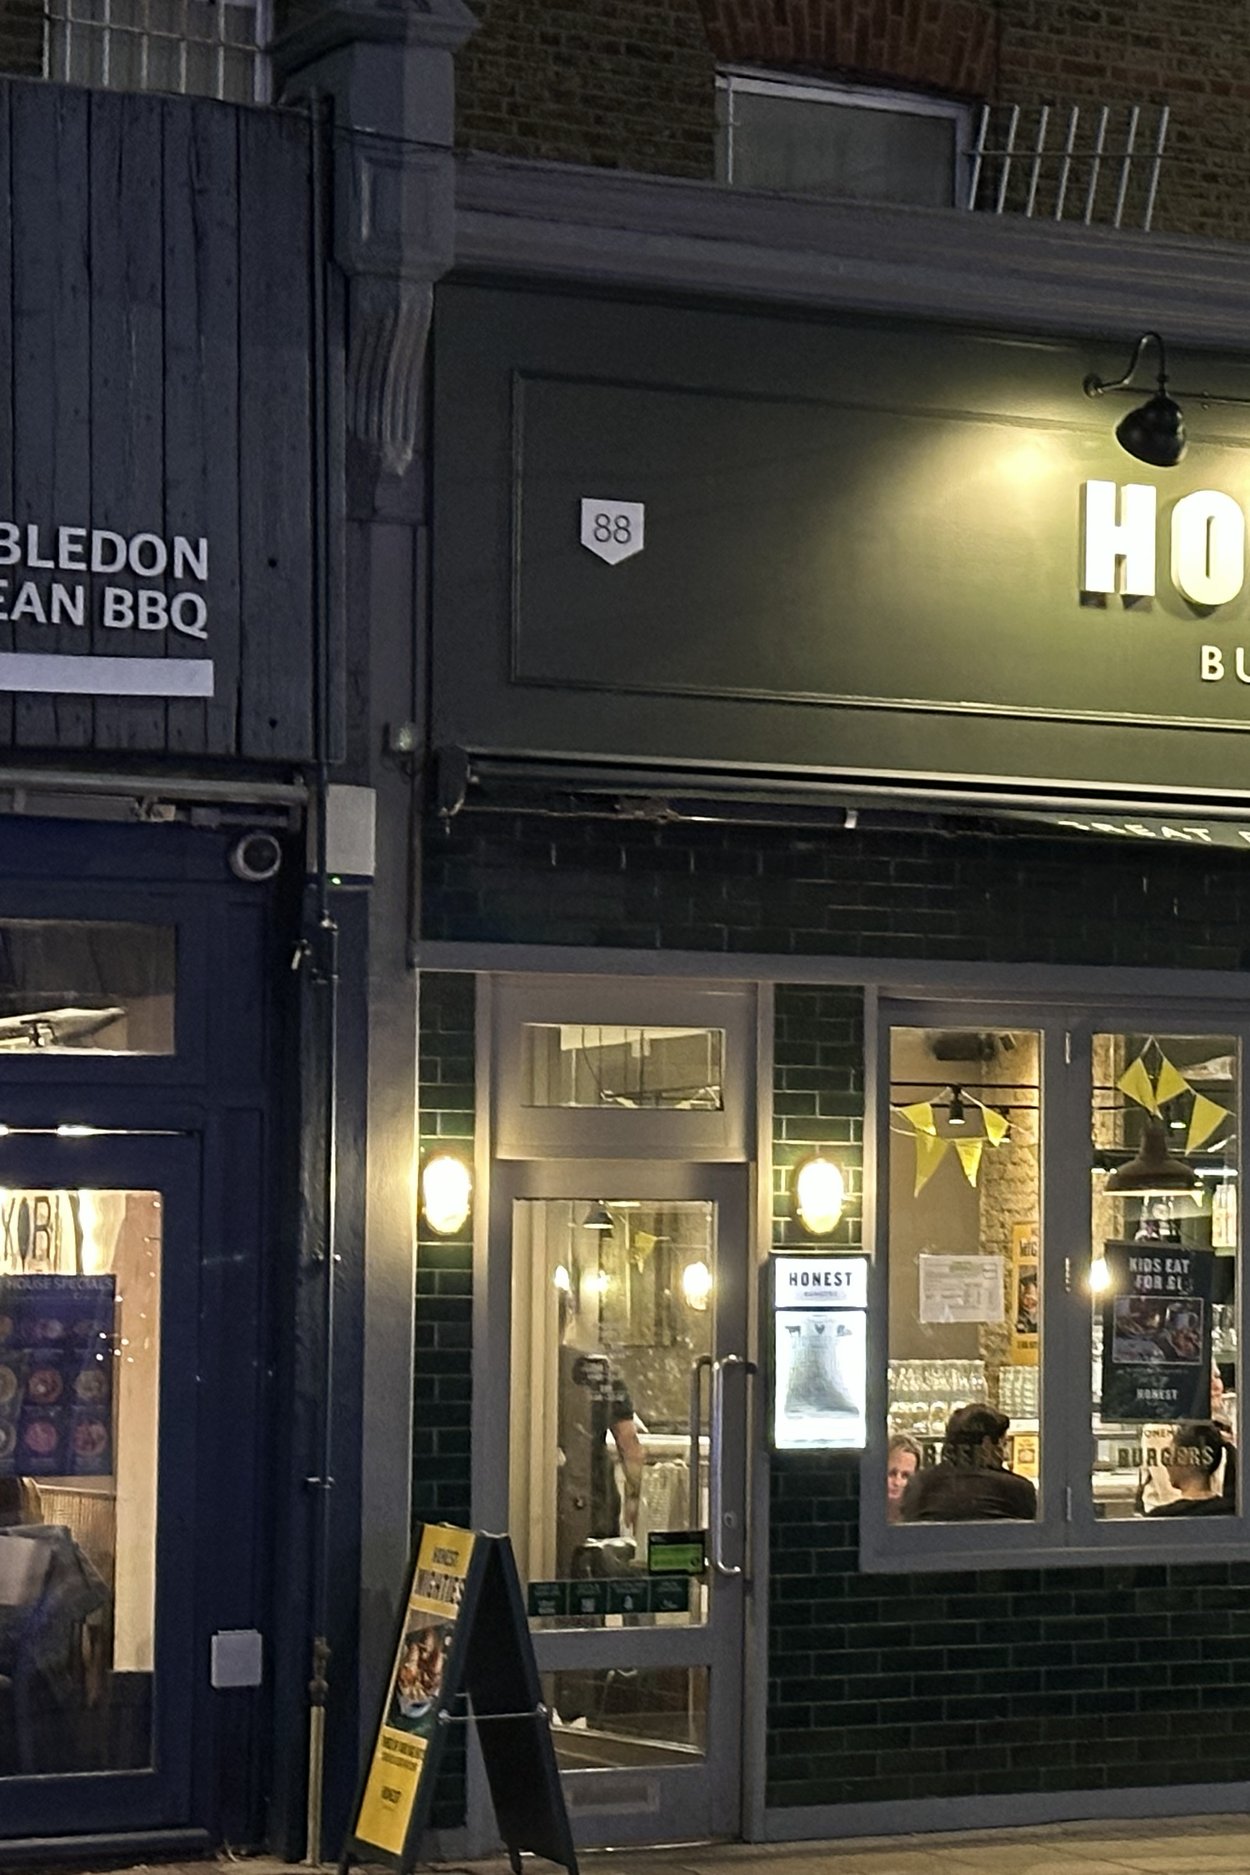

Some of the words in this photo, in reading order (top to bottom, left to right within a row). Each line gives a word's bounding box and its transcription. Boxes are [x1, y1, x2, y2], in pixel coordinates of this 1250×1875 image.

[594, 513, 631, 544] 88
[0, 521, 209, 581] BLEDON
[103, 586, 209, 640] BBQ
[1057, 820, 1213, 842] REAT
[1129, 1257, 1161, 1274] KIDS
[1165, 1259, 1190, 1274] EAT
[789, 1271, 853, 1287] HONEST
[1137, 1274, 1163, 1290] FOR
[1137, 1388, 1178, 1401] HONEST
[1117, 1446, 1215, 1468] BURGERS
